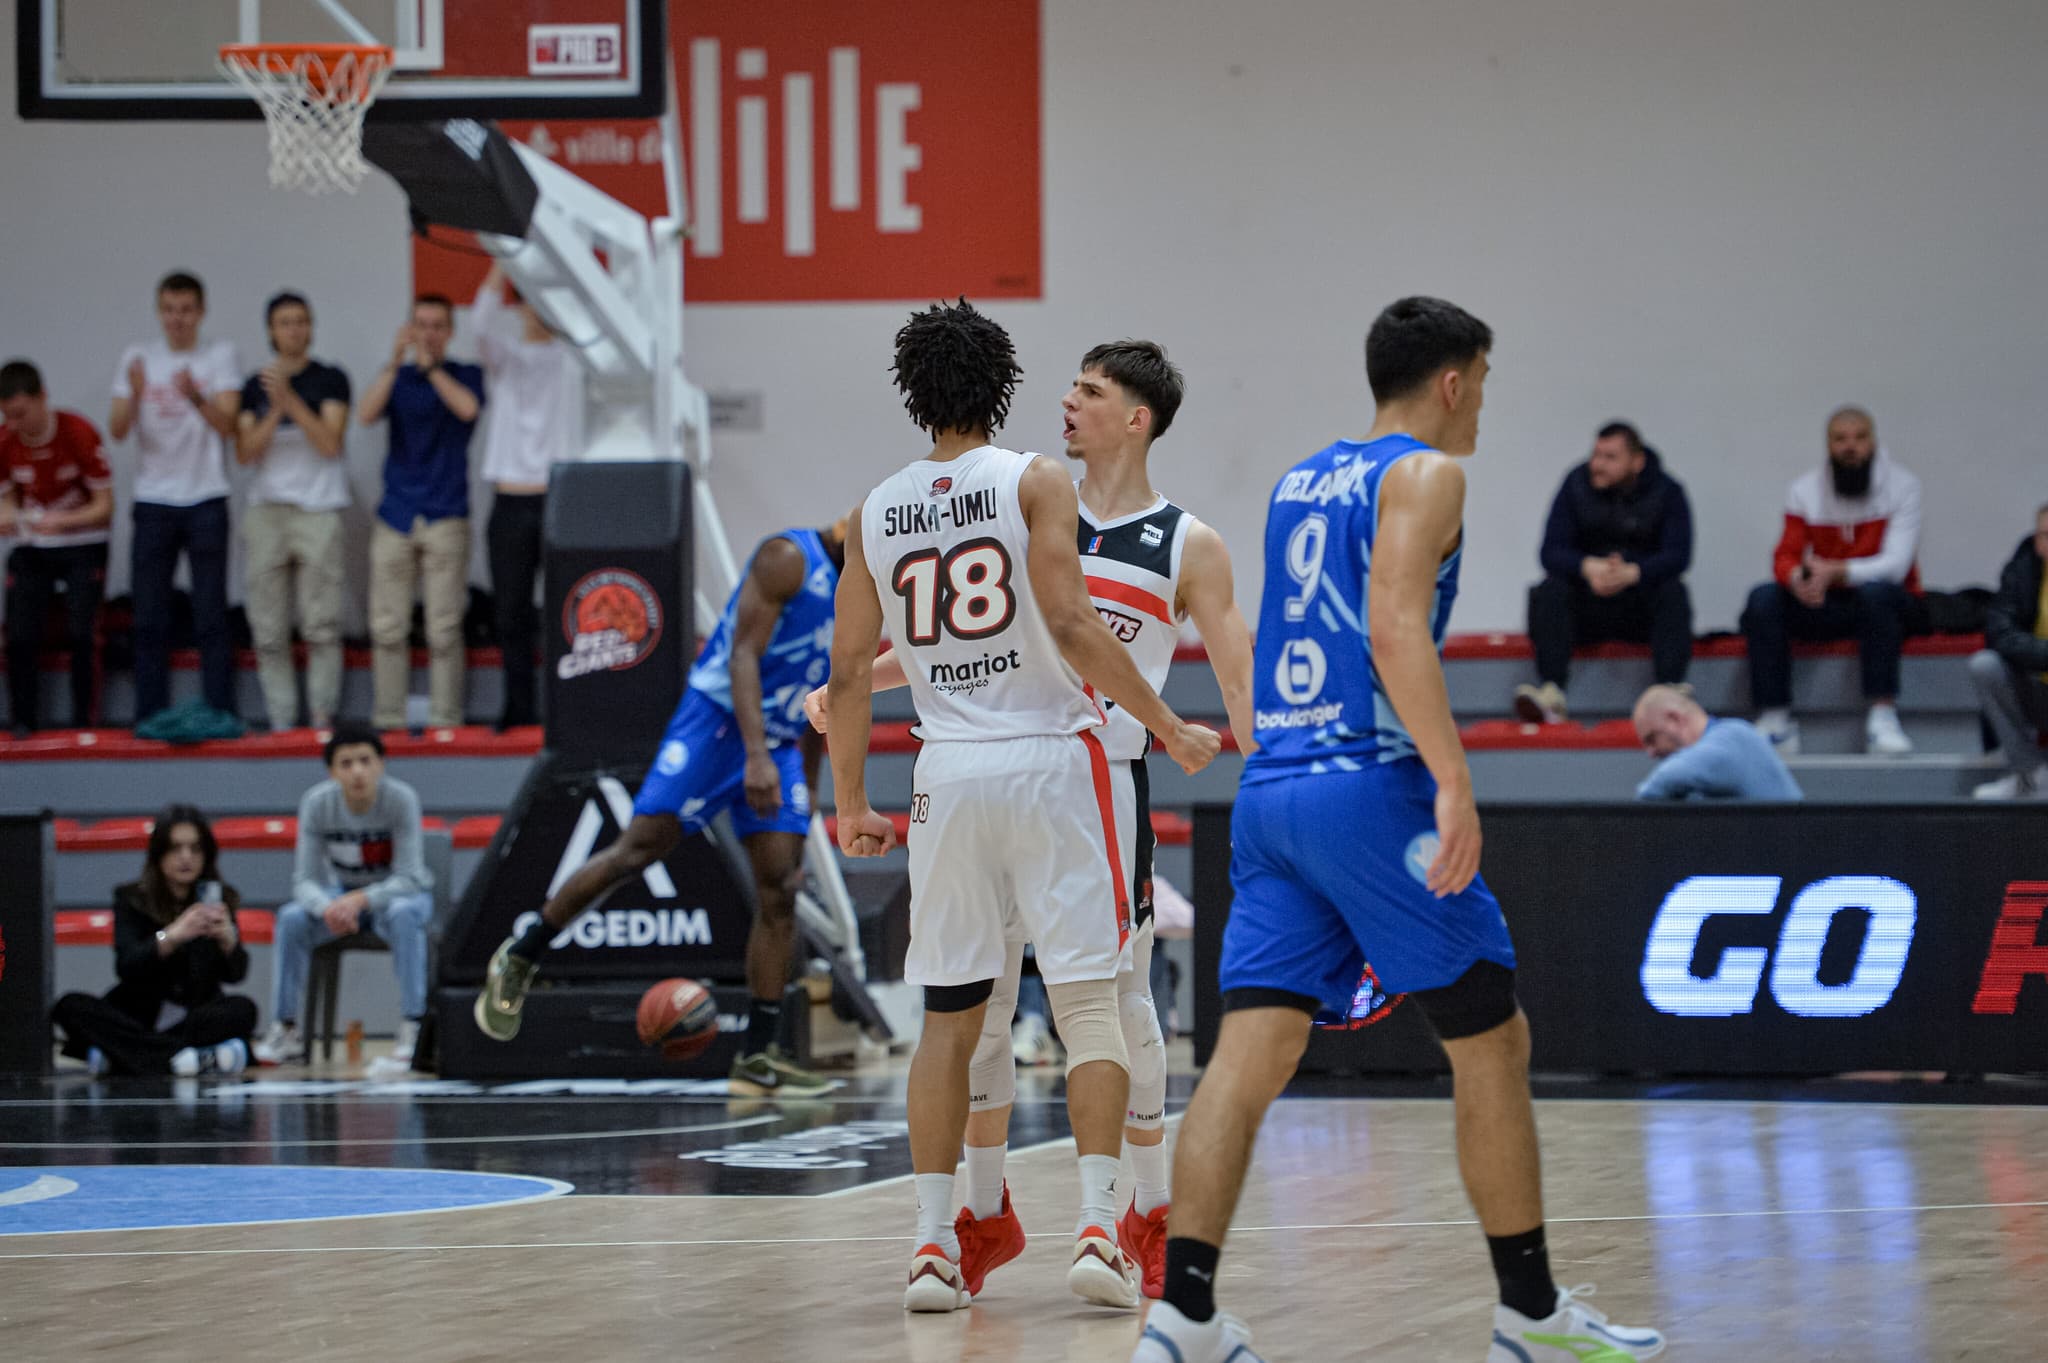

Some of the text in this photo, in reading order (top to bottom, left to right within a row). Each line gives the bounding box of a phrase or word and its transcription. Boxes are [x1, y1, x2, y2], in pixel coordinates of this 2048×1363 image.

[885, 487, 997, 537] SUKA-UMU
[891, 536, 1017, 647] 18
[1284, 511, 1329, 622] 9
[930, 649, 1021, 684] mariot
[1256, 702, 1344, 731] boulanger
[911, 793, 930, 823] 18
[1639, 874, 1918, 1018] GO
